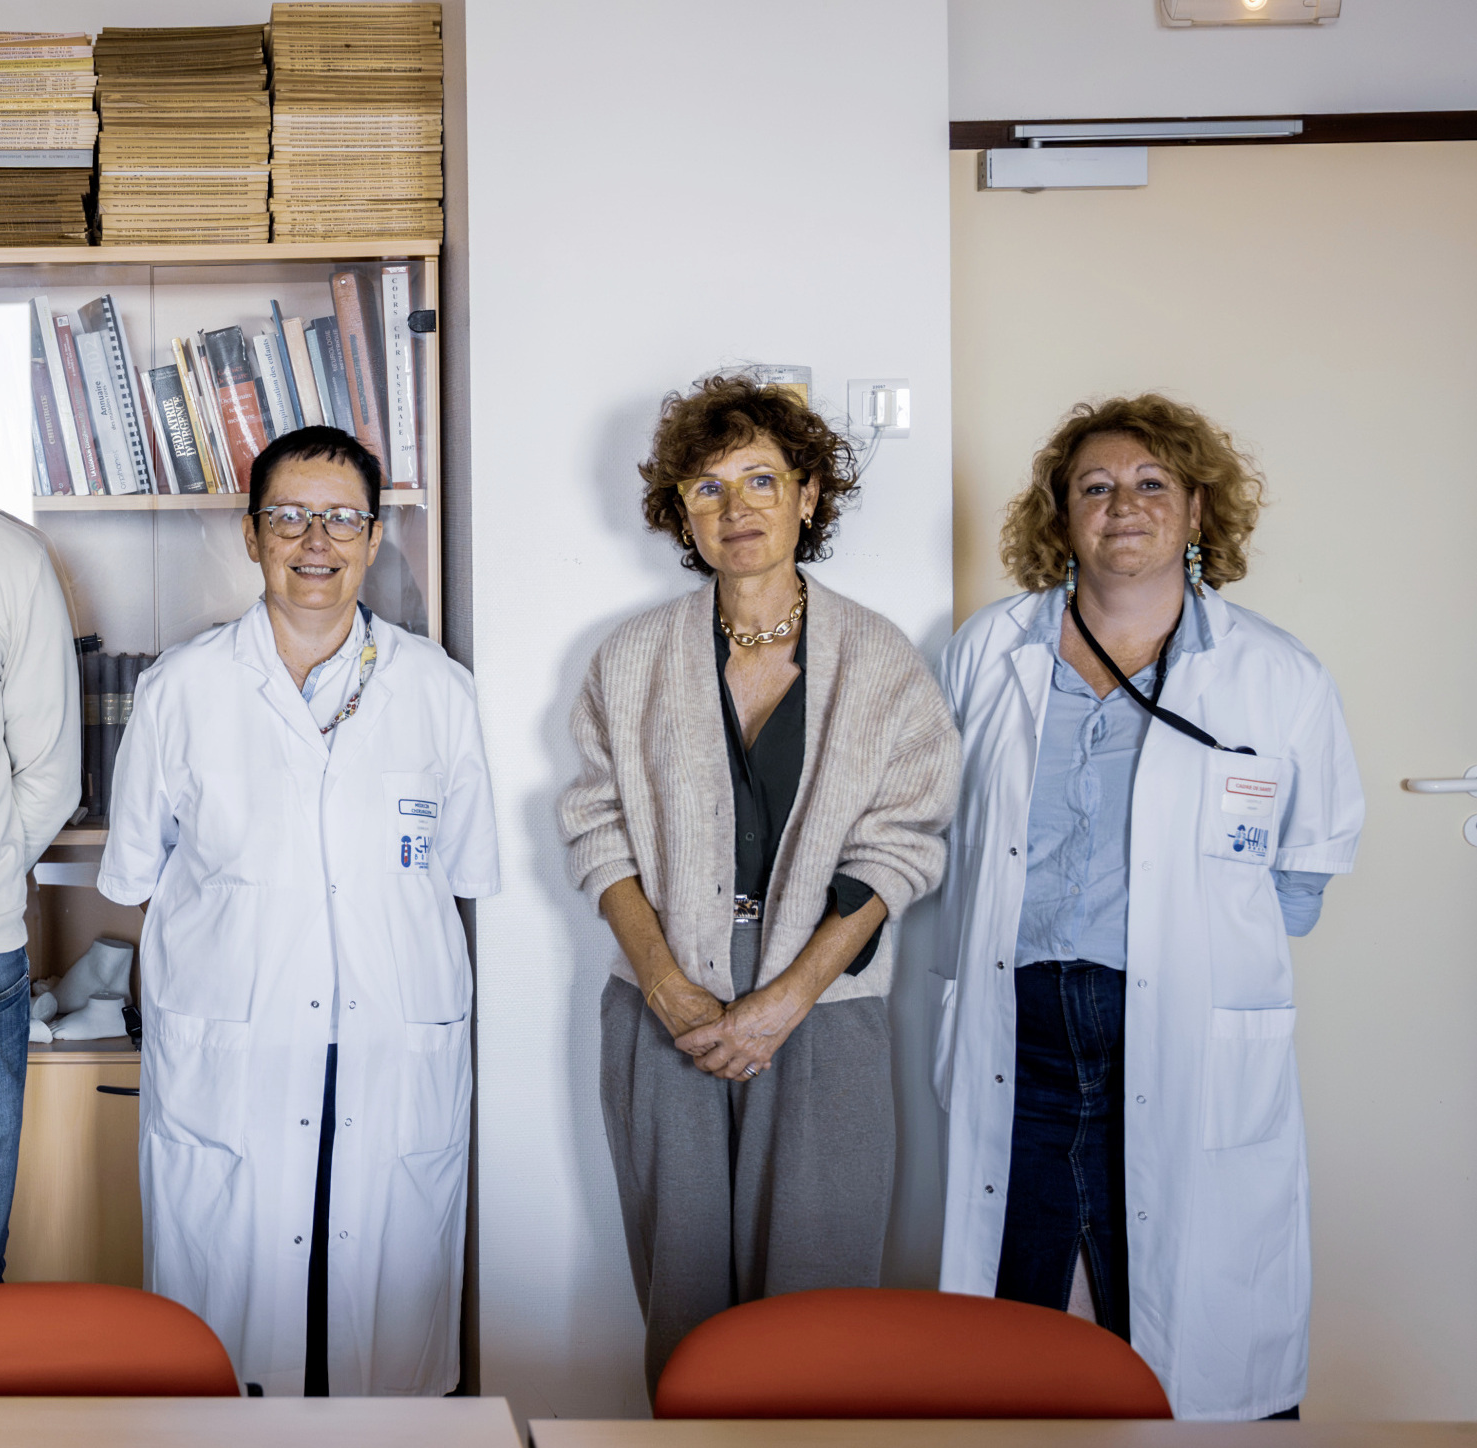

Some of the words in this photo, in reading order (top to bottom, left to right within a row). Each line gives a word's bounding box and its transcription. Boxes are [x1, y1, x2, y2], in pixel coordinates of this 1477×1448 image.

[391, 277, 399, 316] COURS
[264, 338, 274, 365] enfants
[393, 325, 401, 356] CHIR
[269, 365, 277, 378] des
[94, 380, 109, 416] Annuaire
[395, 365, 404, 436] VISCERALE
[40, 394, 56, 445] CHIRURGIE
[162, 398, 186, 458] PEDIATRIE
[174, 394, 197, 457] D'URGENCE
